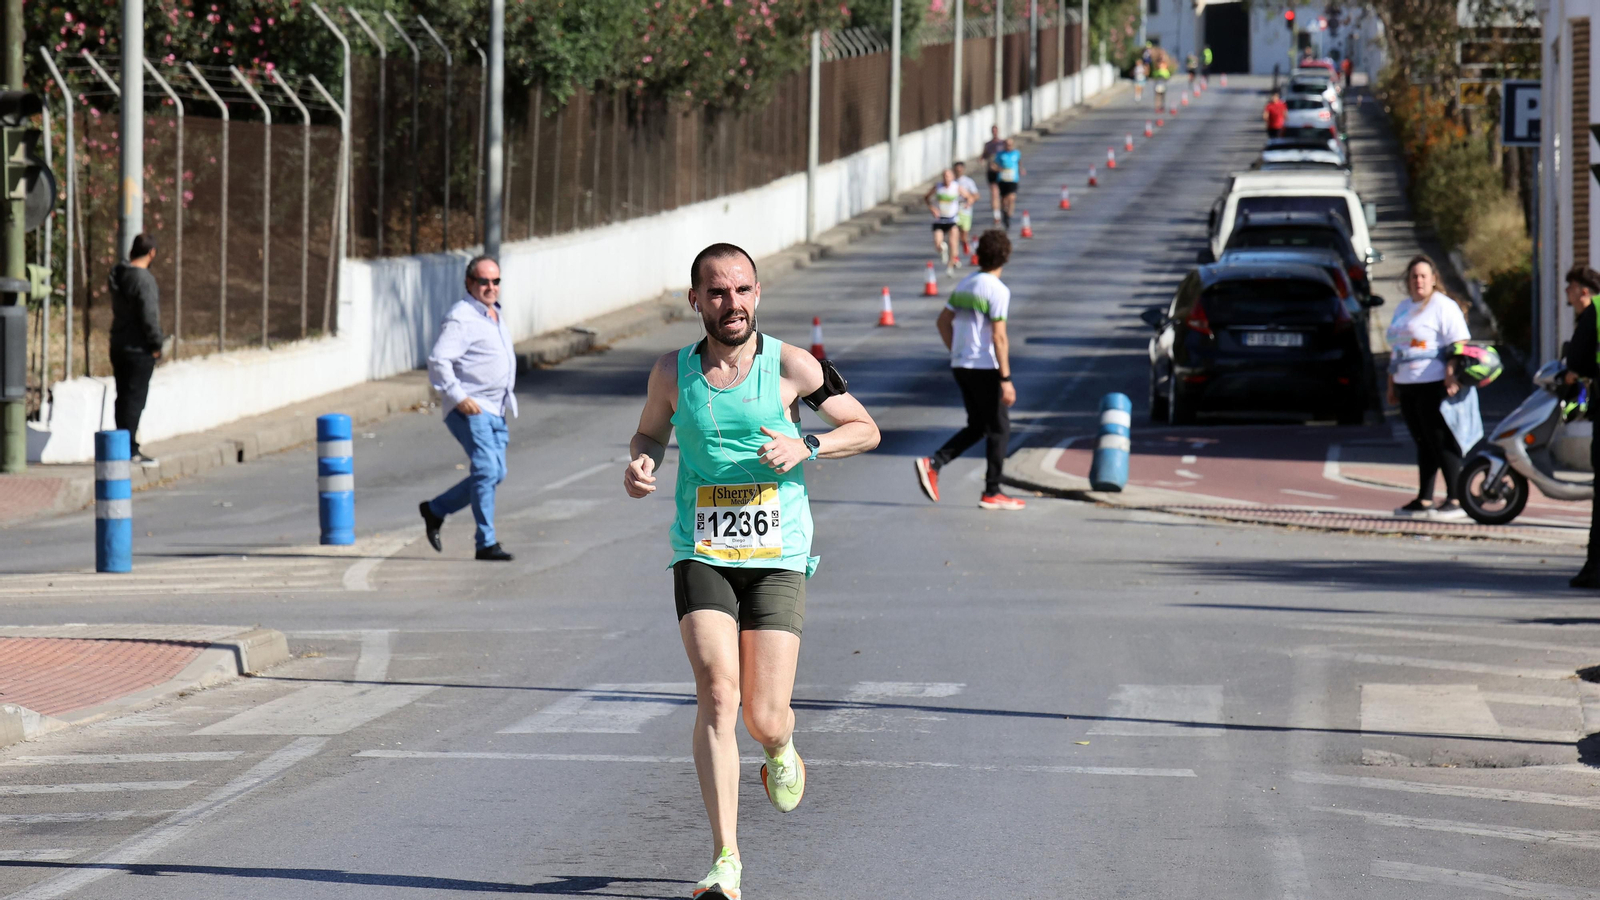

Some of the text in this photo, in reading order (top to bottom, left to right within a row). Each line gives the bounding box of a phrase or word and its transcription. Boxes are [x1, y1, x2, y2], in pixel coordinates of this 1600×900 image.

[1515, 88, 1540, 138] P
[717, 486, 757, 502] Sherry
[708, 510, 768, 537] 1236
